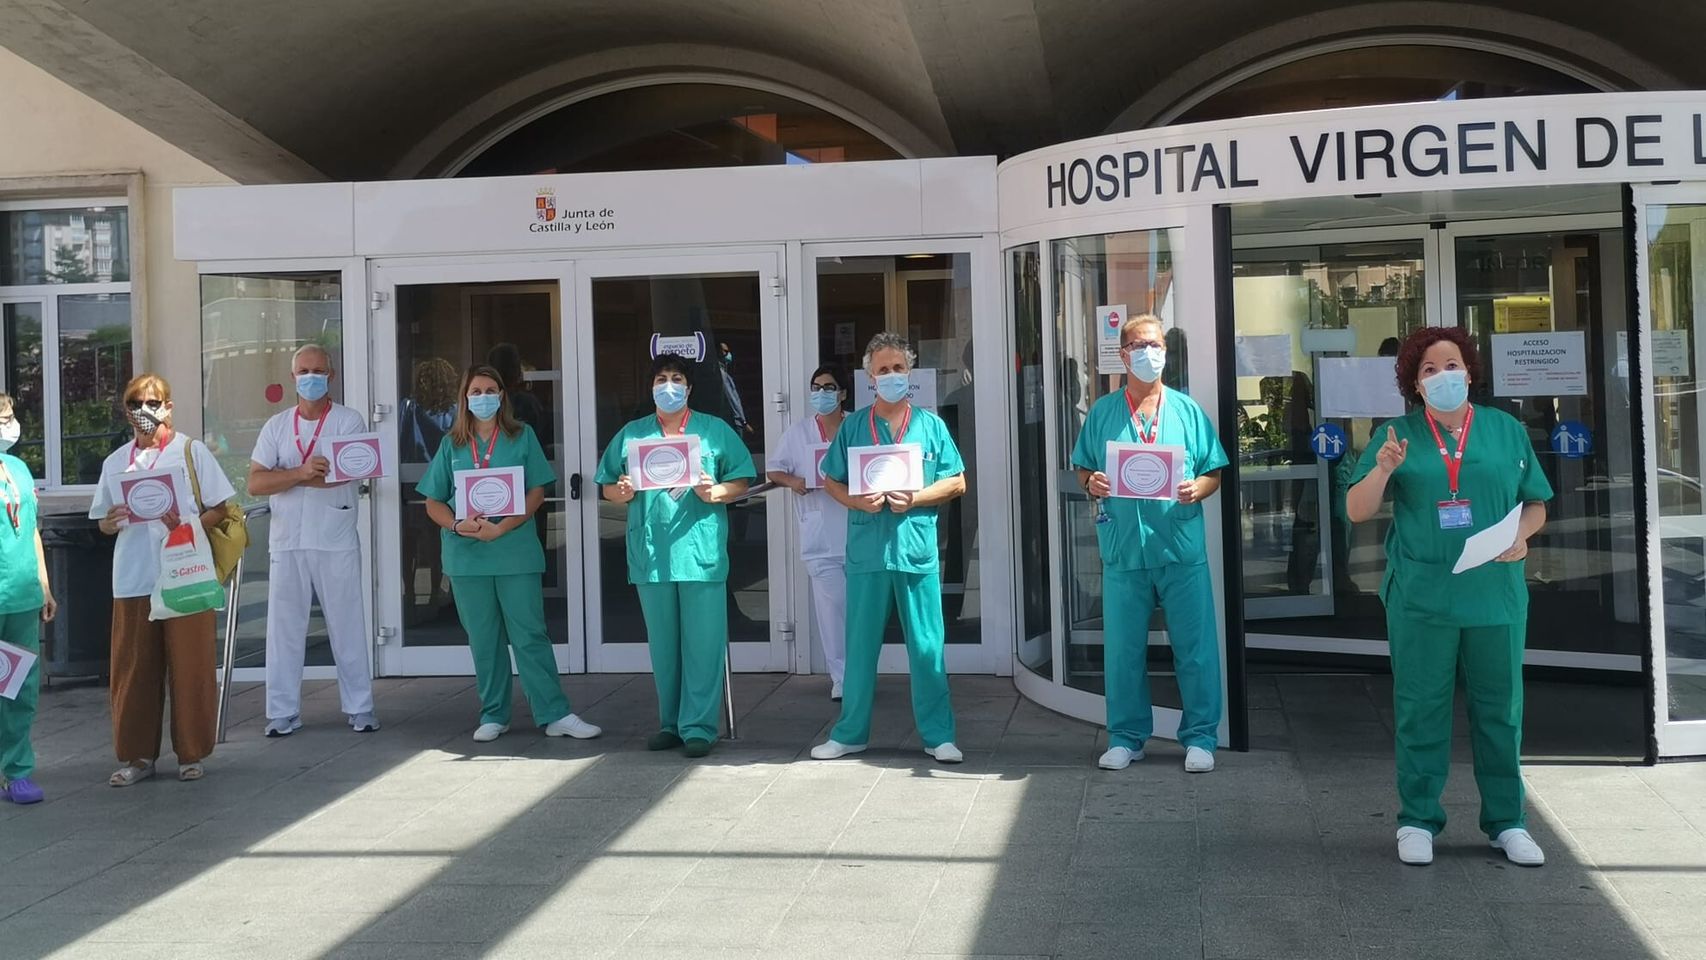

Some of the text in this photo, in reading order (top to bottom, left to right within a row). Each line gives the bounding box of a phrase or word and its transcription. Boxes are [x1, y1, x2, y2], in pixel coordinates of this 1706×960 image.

[1047, 140, 1259, 208] HOSPITAL
[1289, 119, 1547, 184] VIRGEN
[1575, 114, 1665, 169] DE
[562, 208, 614, 219] Junta de
[529, 220, 615, 234] Castilla y León
[1507, 349, 1566, 357] HOSPITALIZACION
[1514, 358, 1560, 366] RESTRINGIDO
